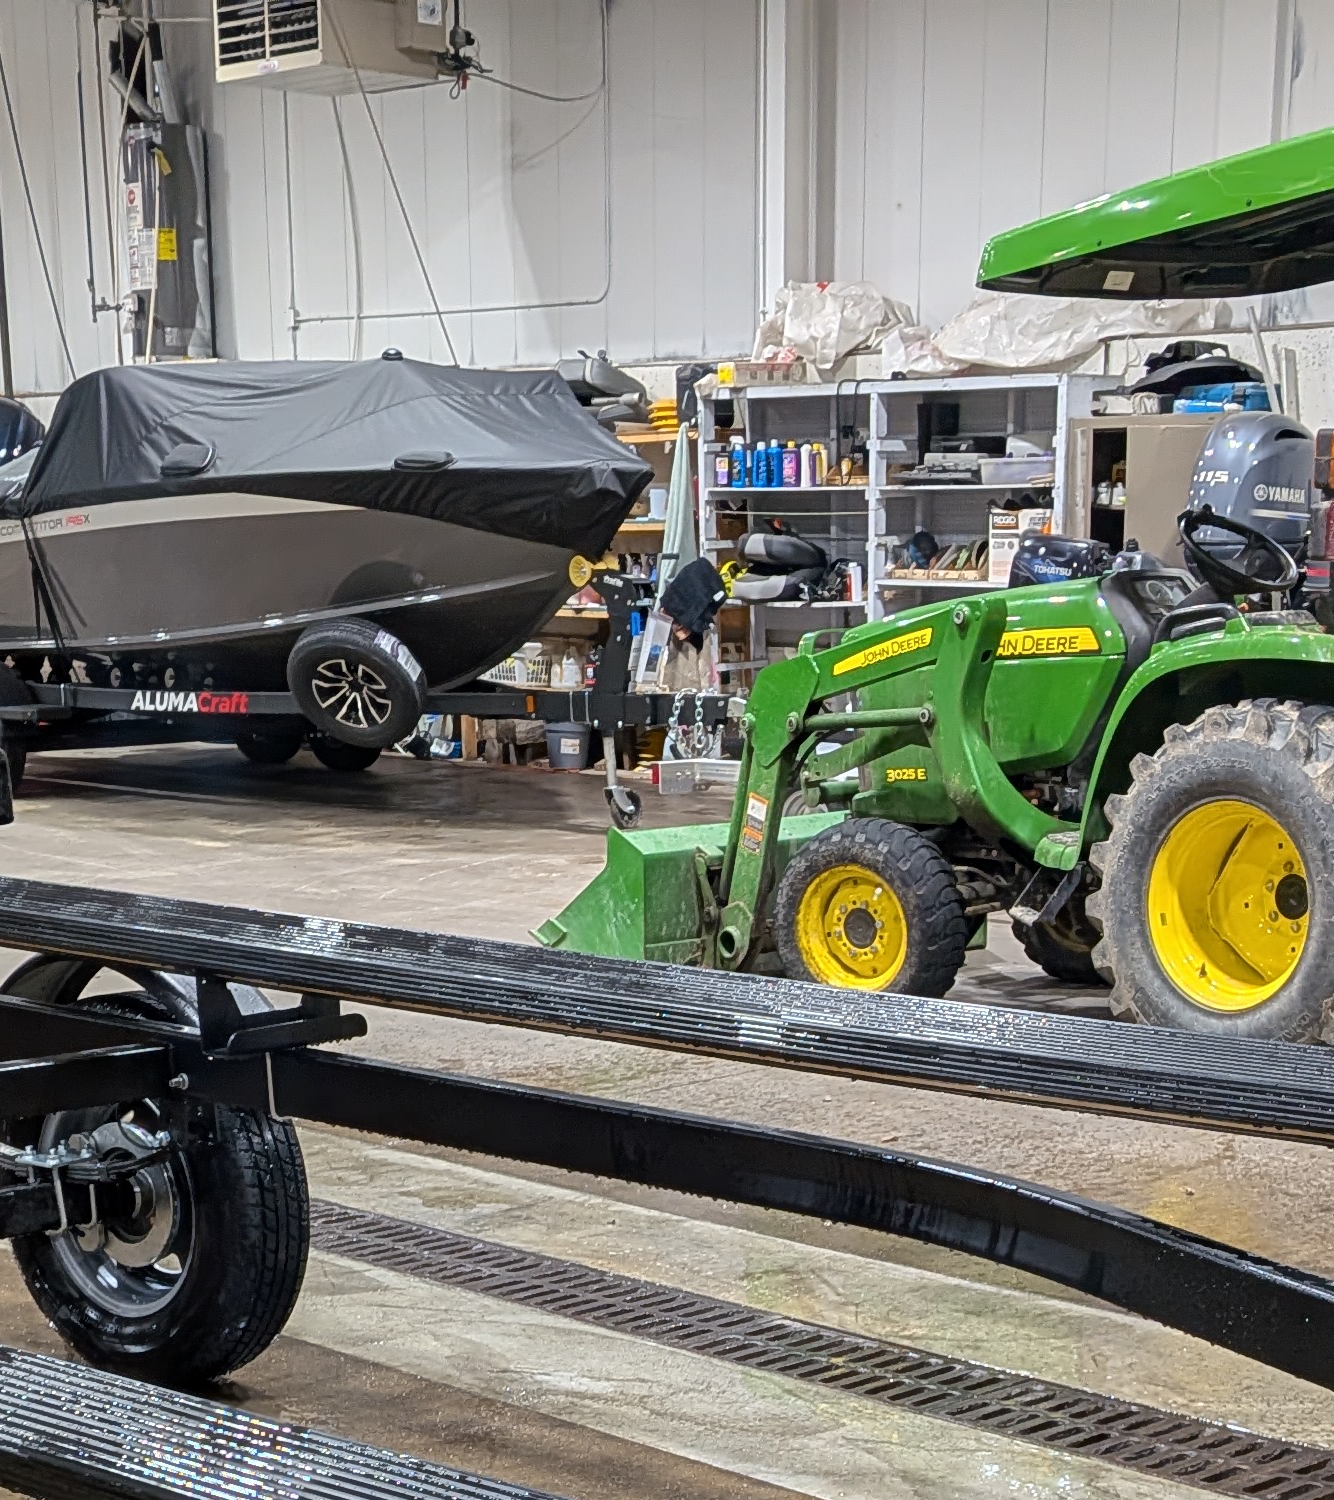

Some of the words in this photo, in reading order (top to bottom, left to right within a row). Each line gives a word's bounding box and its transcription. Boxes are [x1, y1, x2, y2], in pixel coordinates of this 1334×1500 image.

[1198, 470, 1229, 484] 115
[1268, 486, 1306, 503] YAMAHA
[1033, 564, 1073, 577] TOHATSU
[860, 647, 890, 666] JOHN
[890, 634, 928, 657] DEERE
[1021, 634, 1080, 652] DEERE
[130, 689, 248, 713] ALUMACraft
